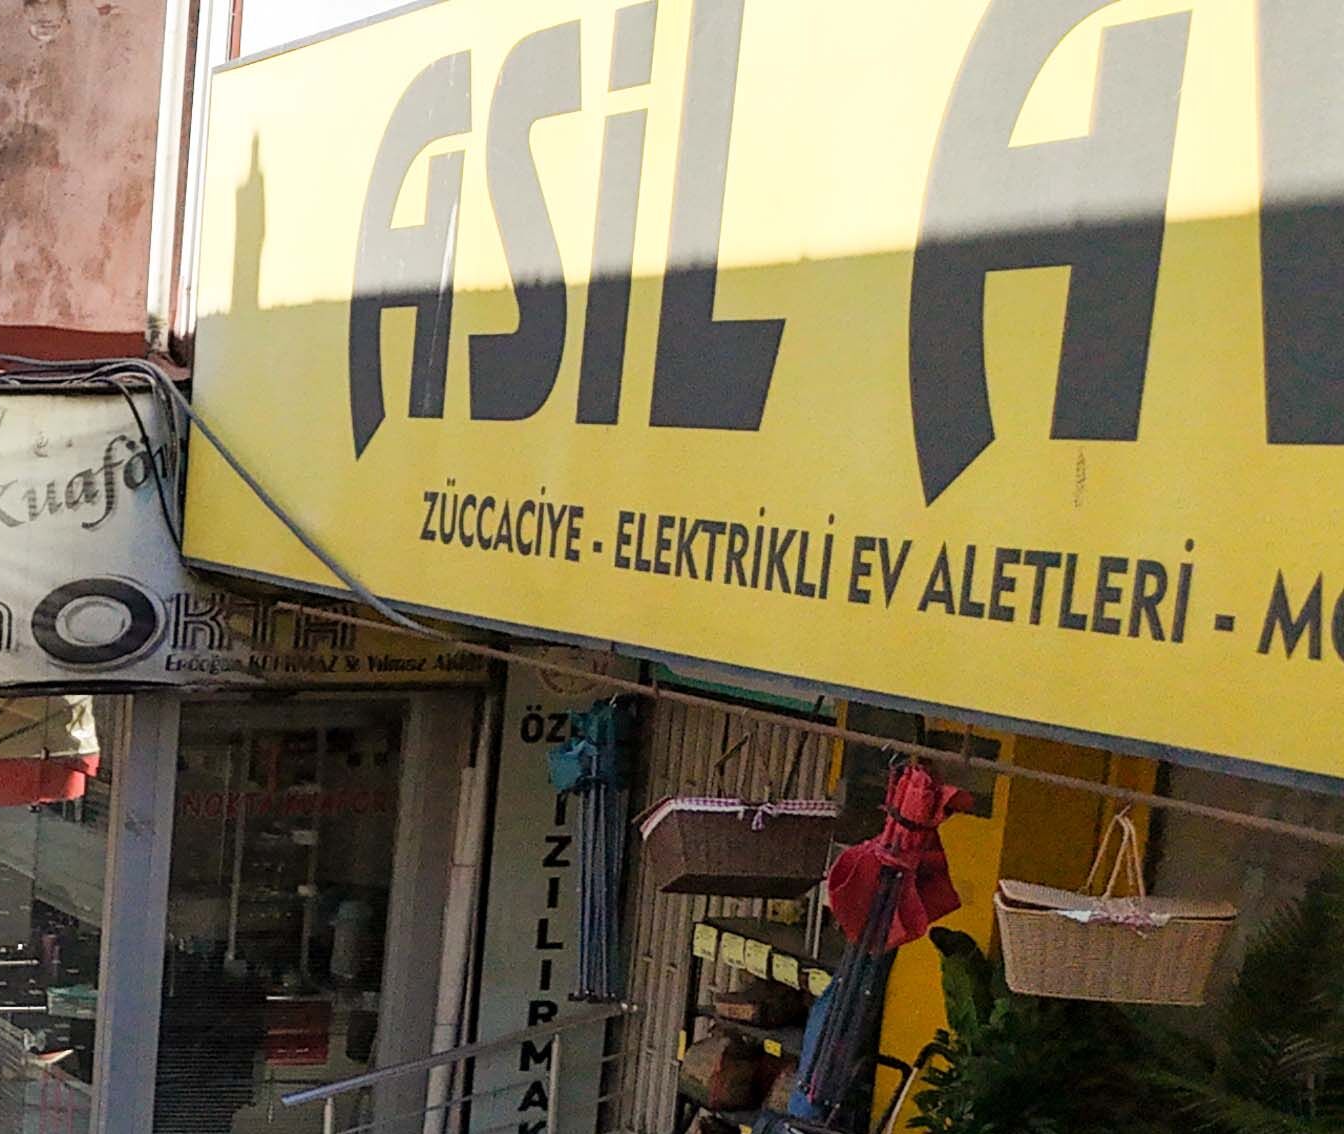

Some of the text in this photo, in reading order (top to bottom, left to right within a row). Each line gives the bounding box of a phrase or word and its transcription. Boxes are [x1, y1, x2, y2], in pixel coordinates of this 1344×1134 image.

[909, 0, 1344, 506] A
[421, 479, 584, 563] ZÜCCACİYE
[614, 506, 833, 601] ELEKTRİKLİ
[848, 535, 911, 610] EV
[917, 538, 1196, 643] ALETLERİ
